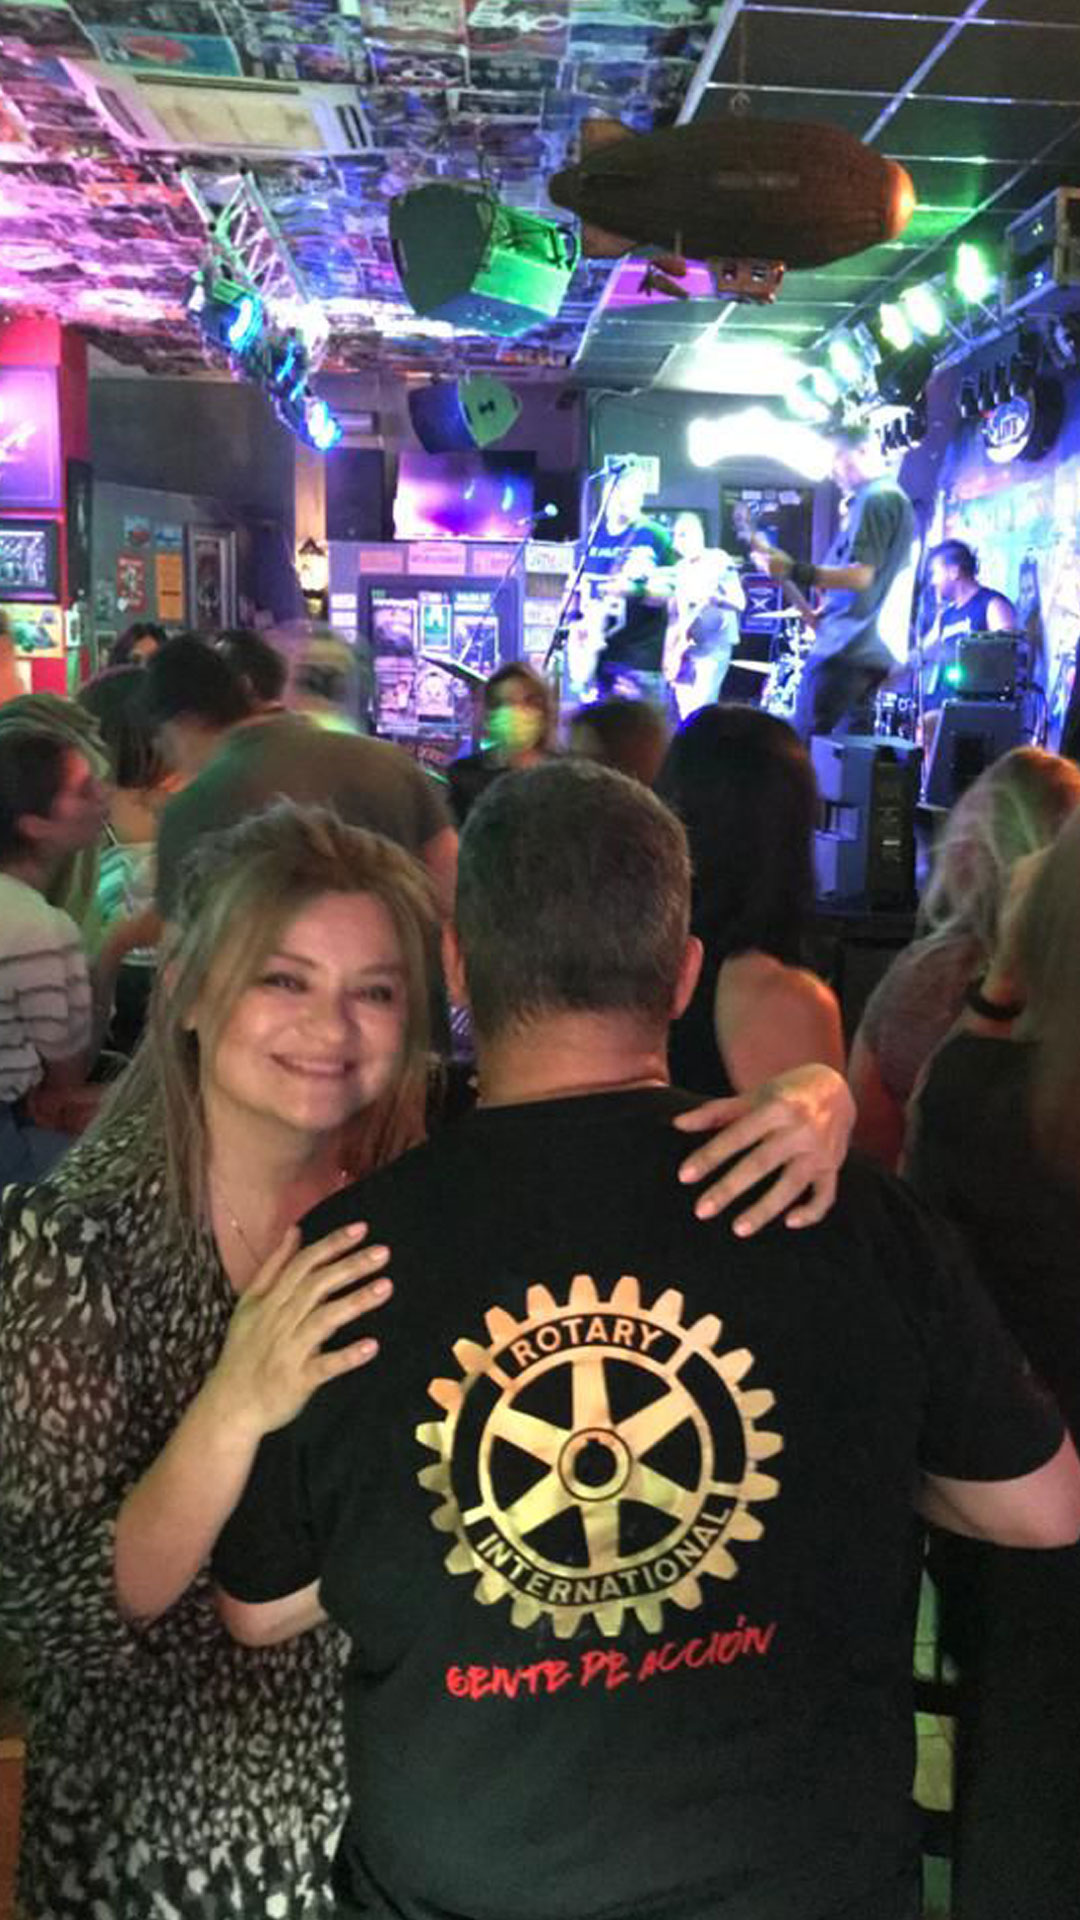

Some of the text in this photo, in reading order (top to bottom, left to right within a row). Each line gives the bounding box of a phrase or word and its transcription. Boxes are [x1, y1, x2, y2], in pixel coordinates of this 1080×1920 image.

[511, 1316, 664, 1368] ROTARY
[476, 1507, 731, 1602] INTERNATIONAL
[445, 1659, 573, 1701] GENTE
[580, 1648, 632, 1690] DE
